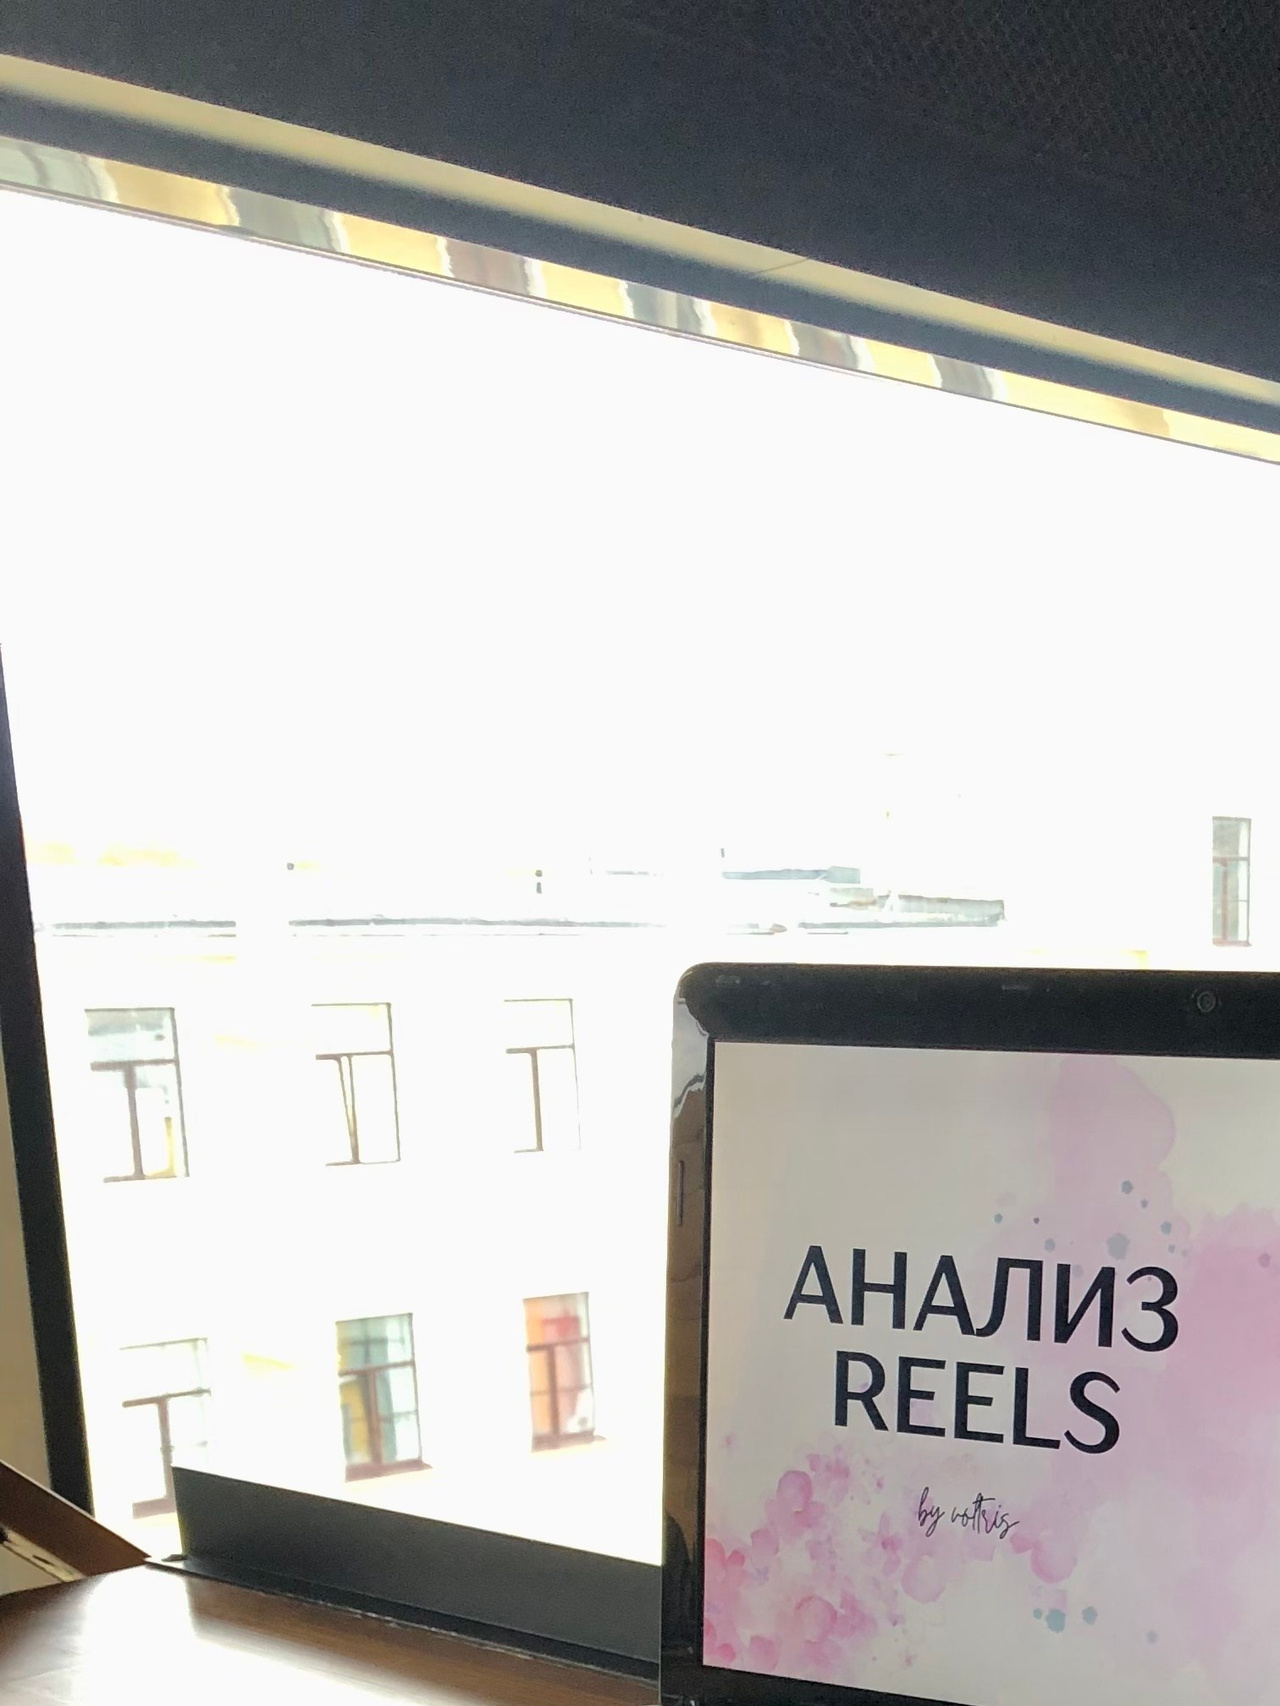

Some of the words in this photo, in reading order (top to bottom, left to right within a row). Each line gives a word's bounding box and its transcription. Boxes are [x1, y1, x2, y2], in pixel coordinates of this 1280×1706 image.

[783, 1244, 1180, 1352] АНАЛИЗ
[833, 1350, 1121, 1455] REELS
[918, 1486, 945, 1538] by
